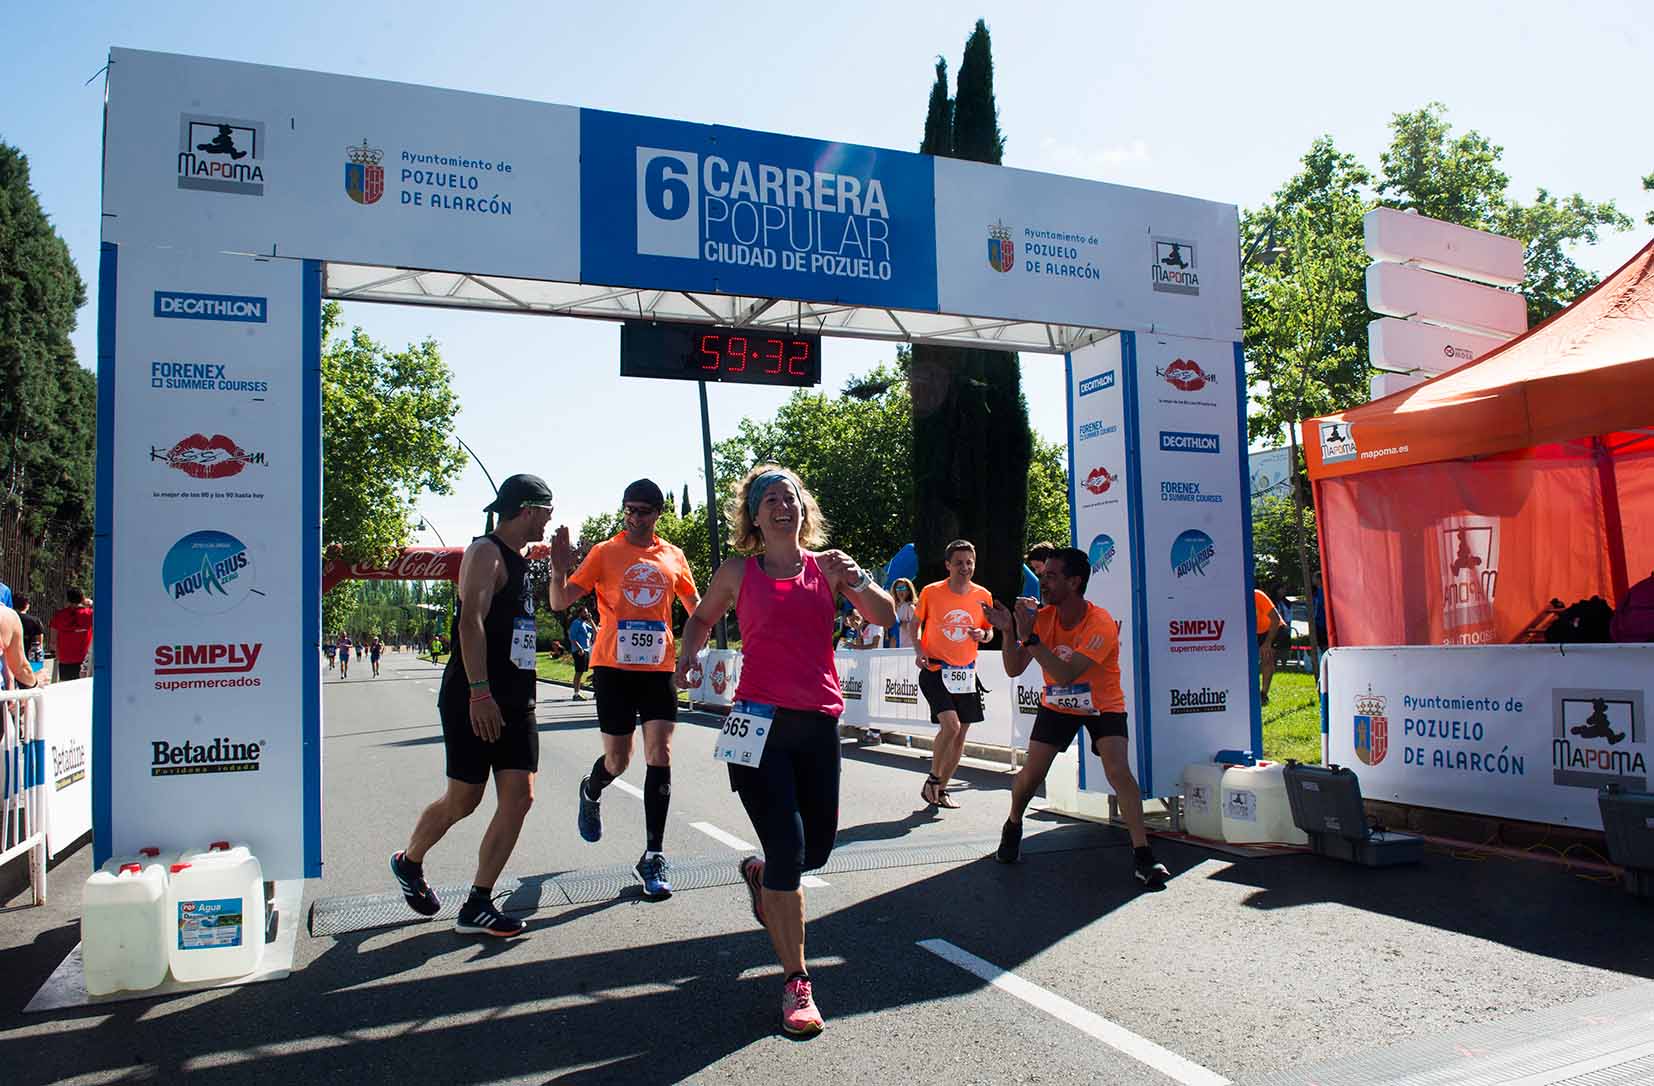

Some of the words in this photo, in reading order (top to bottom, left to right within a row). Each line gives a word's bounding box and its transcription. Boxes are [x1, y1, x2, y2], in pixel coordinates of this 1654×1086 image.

[178, 151, 264, 182] MAPOMA
[401, 150, 492, 171] Ayuntamiento
[497, 158, 512, 173] de
[401, 169, 478, 190] POZUELO
[645, 155, 690, 221] 6
[703, 155, 889, 219] CARRERA
[401, 191, 422, 206] DE
[431, 192, 512, 216] ALARCÓN
[705, 196, 890, 260] POPULAR
[1025, 228, 1085, 244] Ayuntamiento
[1087, 235, 1098, 245] de
[704, 240, 776, 269] CIUDAD
[782, 249, 806, 272] DE
[811, 253, 892, 280] POZUELO
[1025, 242, 1077, 259] POZUELO
[1025, 260, 1040, 273] DE
[1046, 263, 1100, 280] ALARCÓN
[1151, 264, 1199, 286] MAPOMA
[160, 297, 261, 317] DECATHLON
[151, 362, 226, 379] FORENEX
[166, 378, 215, 390] SUMMER
[218, 380, 268, 392] COURSES
[1080, 374, 1113, 393] DECATHLON
[1162, 435, 1217, 449] DECATHLON
[1321, 441, 1357, 459] MAPOMA
[1360, 445, 1408, 460] mapoma.es
[1160, 481, 1200, 494] FORENEX
[1177, 544, 1216, 578] AQUARIUS
[175, 551, 248, 600] AQUARIUS
[631, 633, 653, 647] 559
[1170, 643, 1226, 653] supermercados
[154, 676, 261, 692] supermercados
[951, 671, 967, 681] 560
[885, 678, 918, 696] Betadine
[1170, 687, 1227, 707] Betadine
[1403, 695, 1500, 715] Ayuntamiento
[1504, 697, 1523, 713] de
[1404, 718, 1484, 741] POZUELO
[51, 739, 85, 777] Betadine
[152, 737, 260, 765] Betadine
[1404, 746, 1425, 766] DE
[1433, 746, 1525, 775] ALARCÓN
[1552, 737, 1647, 776] MAPOMA
